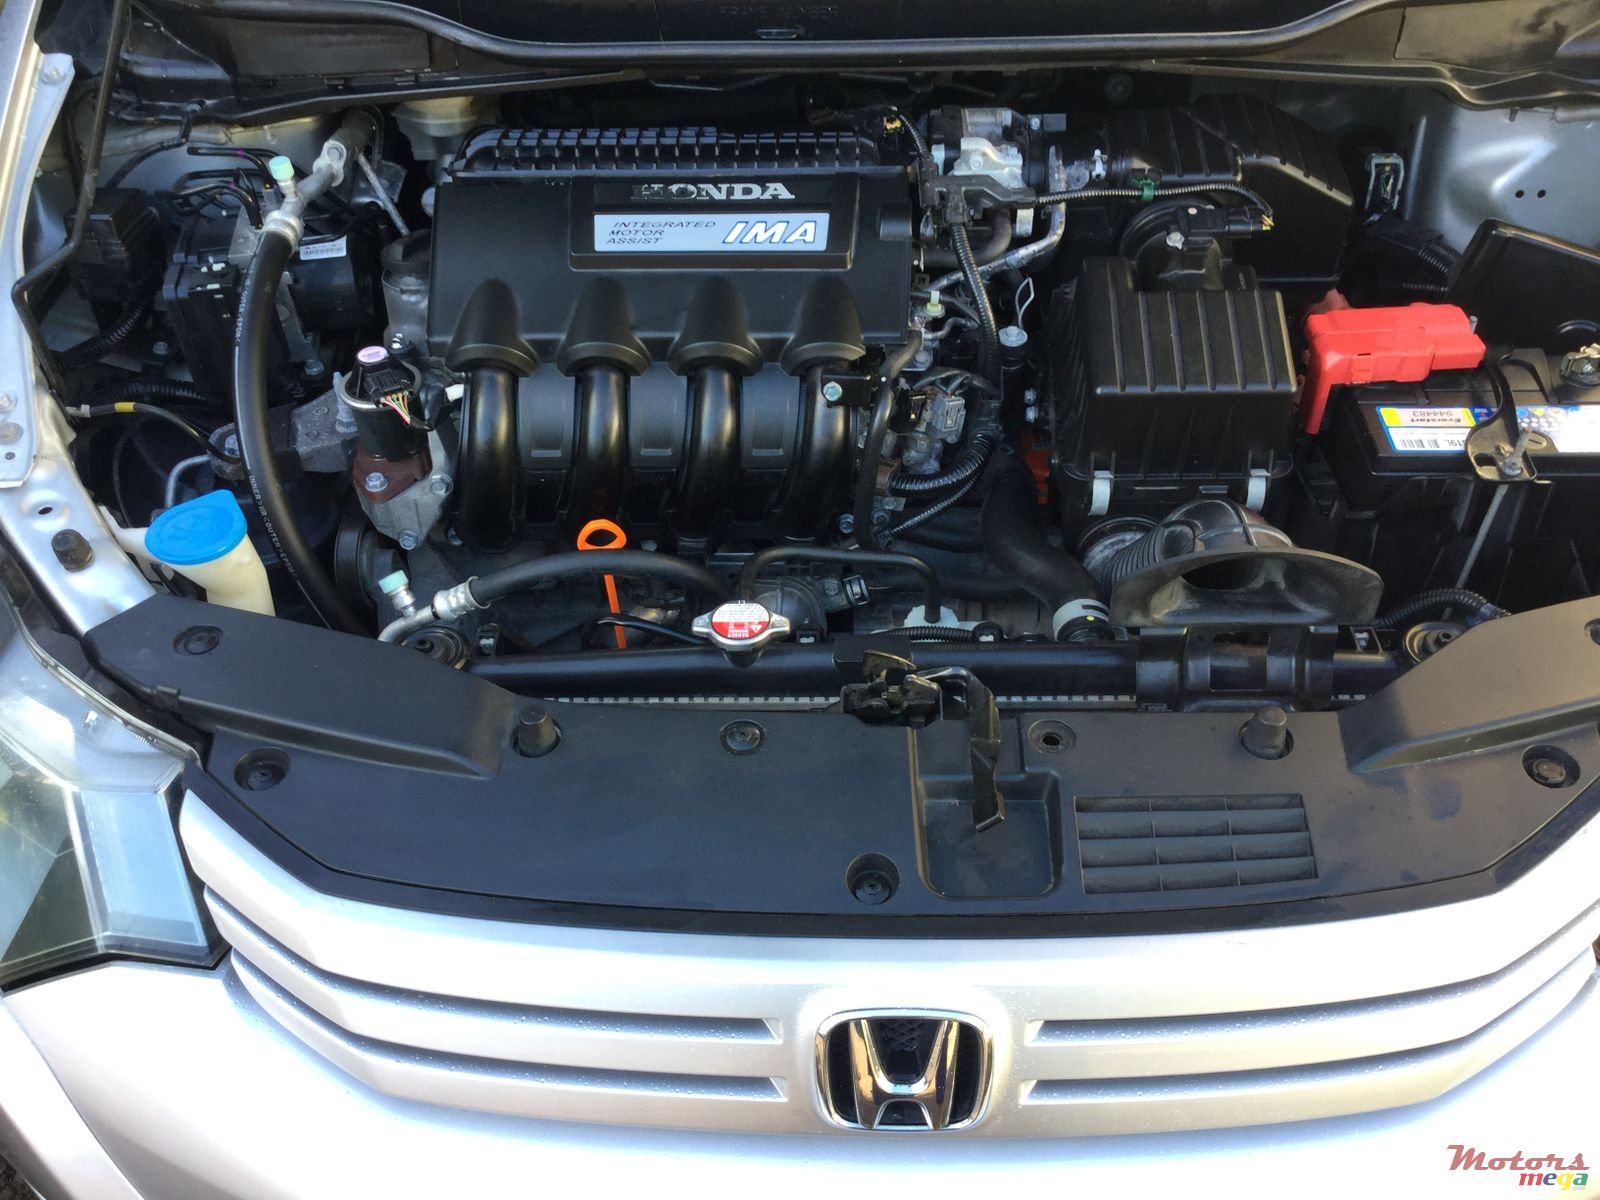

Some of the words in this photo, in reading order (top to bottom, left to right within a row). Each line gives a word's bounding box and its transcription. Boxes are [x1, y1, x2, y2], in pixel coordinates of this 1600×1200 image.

[631, 183, 796, 200] HONDA
[721, 220, 817, 244] IMA
[605, 237, 664, 245] ASSIST
